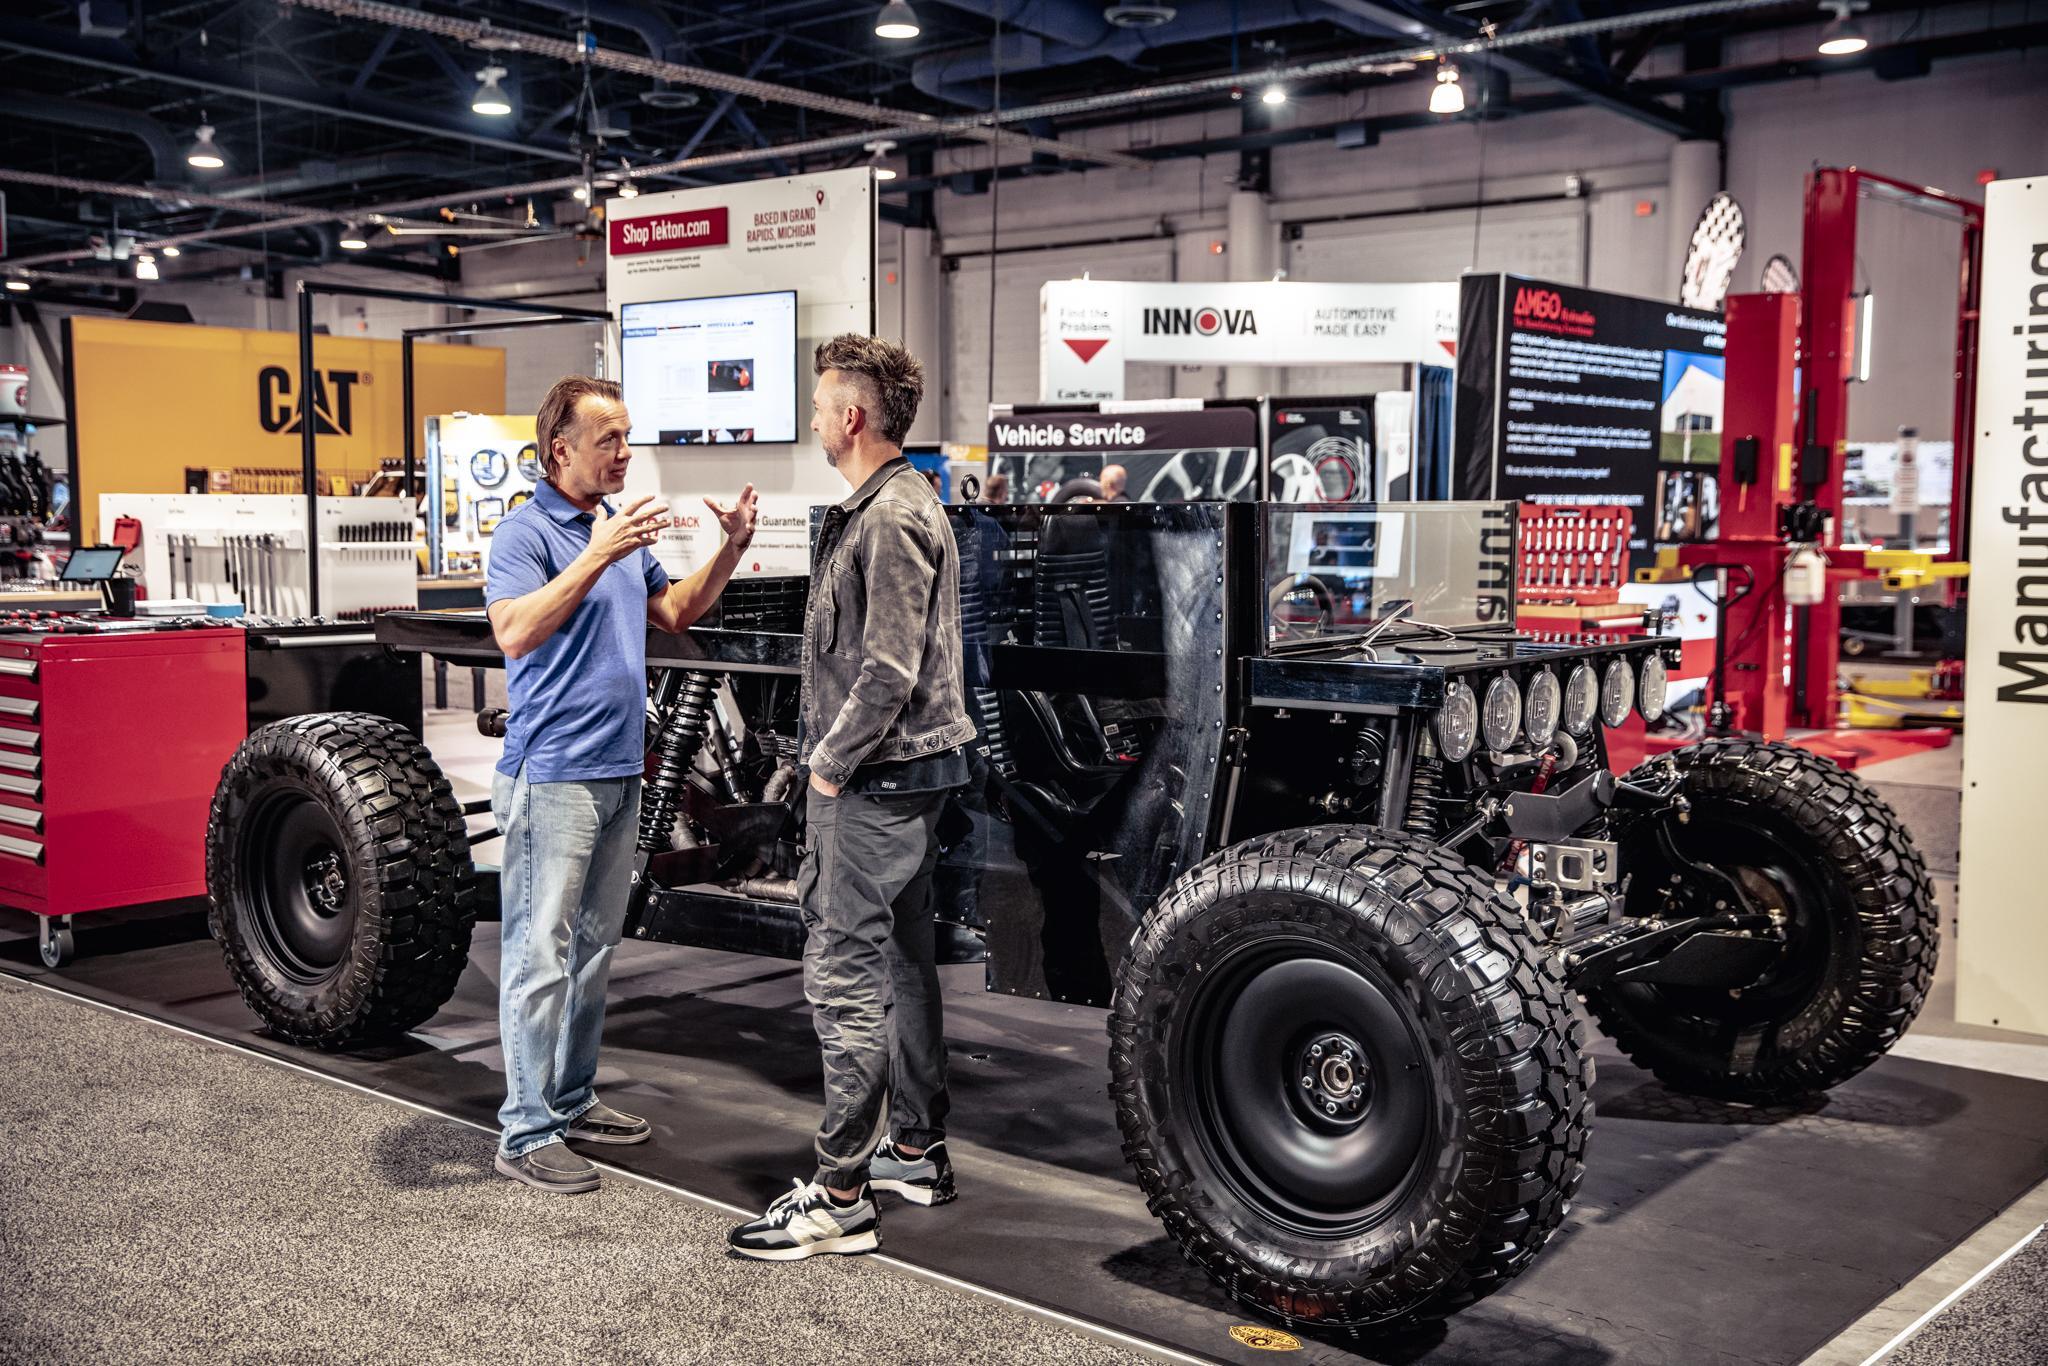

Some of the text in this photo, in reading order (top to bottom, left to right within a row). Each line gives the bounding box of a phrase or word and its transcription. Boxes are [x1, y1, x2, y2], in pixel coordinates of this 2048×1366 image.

[754, 207, 816, 226] BASED IN GRAND
[623, 219, 710, 247] Shop Tekton.com
[746, 223, 816, 242] RAPIDS, MICHIGAN
[1143, 306, 1258, 337] INNOVA
[1314, 306, 1397, 321] AUTOMOTIVE
[1313, 322, 1388, 337] MADE EASY
[258, 365, 359, 436] CAT
[994, 421, 1147, 447] Vehicle Service
[673, 516, 700, 528] BACK
[762, 515, 807, 527] Guarantee
